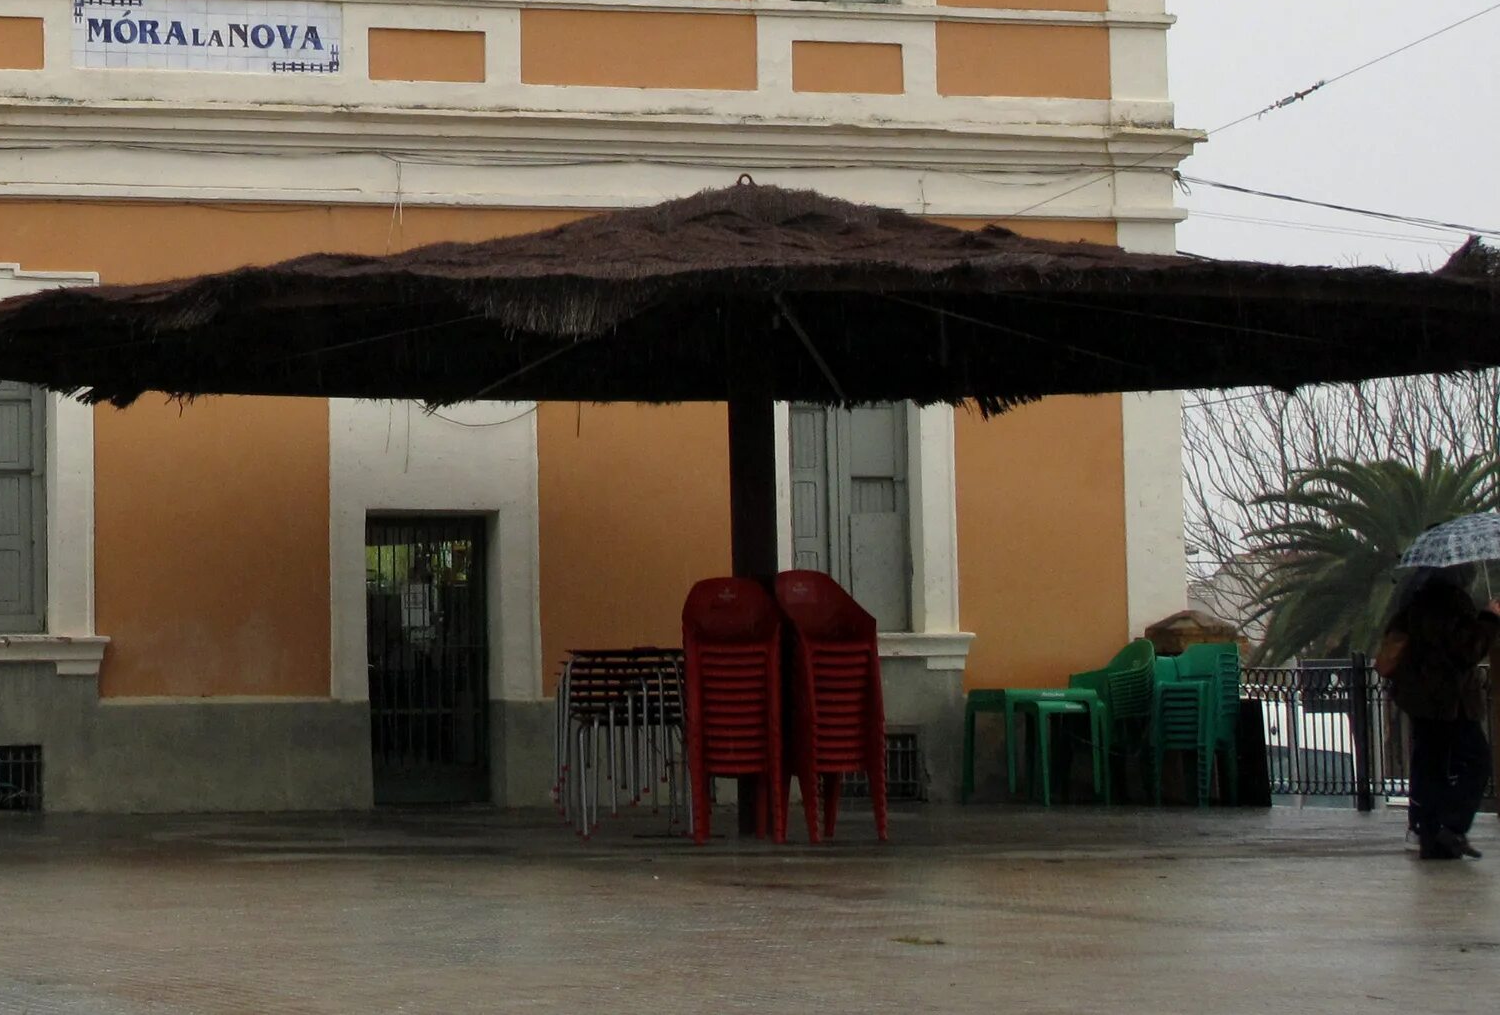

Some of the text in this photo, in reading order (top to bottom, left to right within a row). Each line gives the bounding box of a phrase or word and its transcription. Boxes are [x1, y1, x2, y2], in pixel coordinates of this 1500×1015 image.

[87, 10, 324, 51] MÓRA LA NOVA
